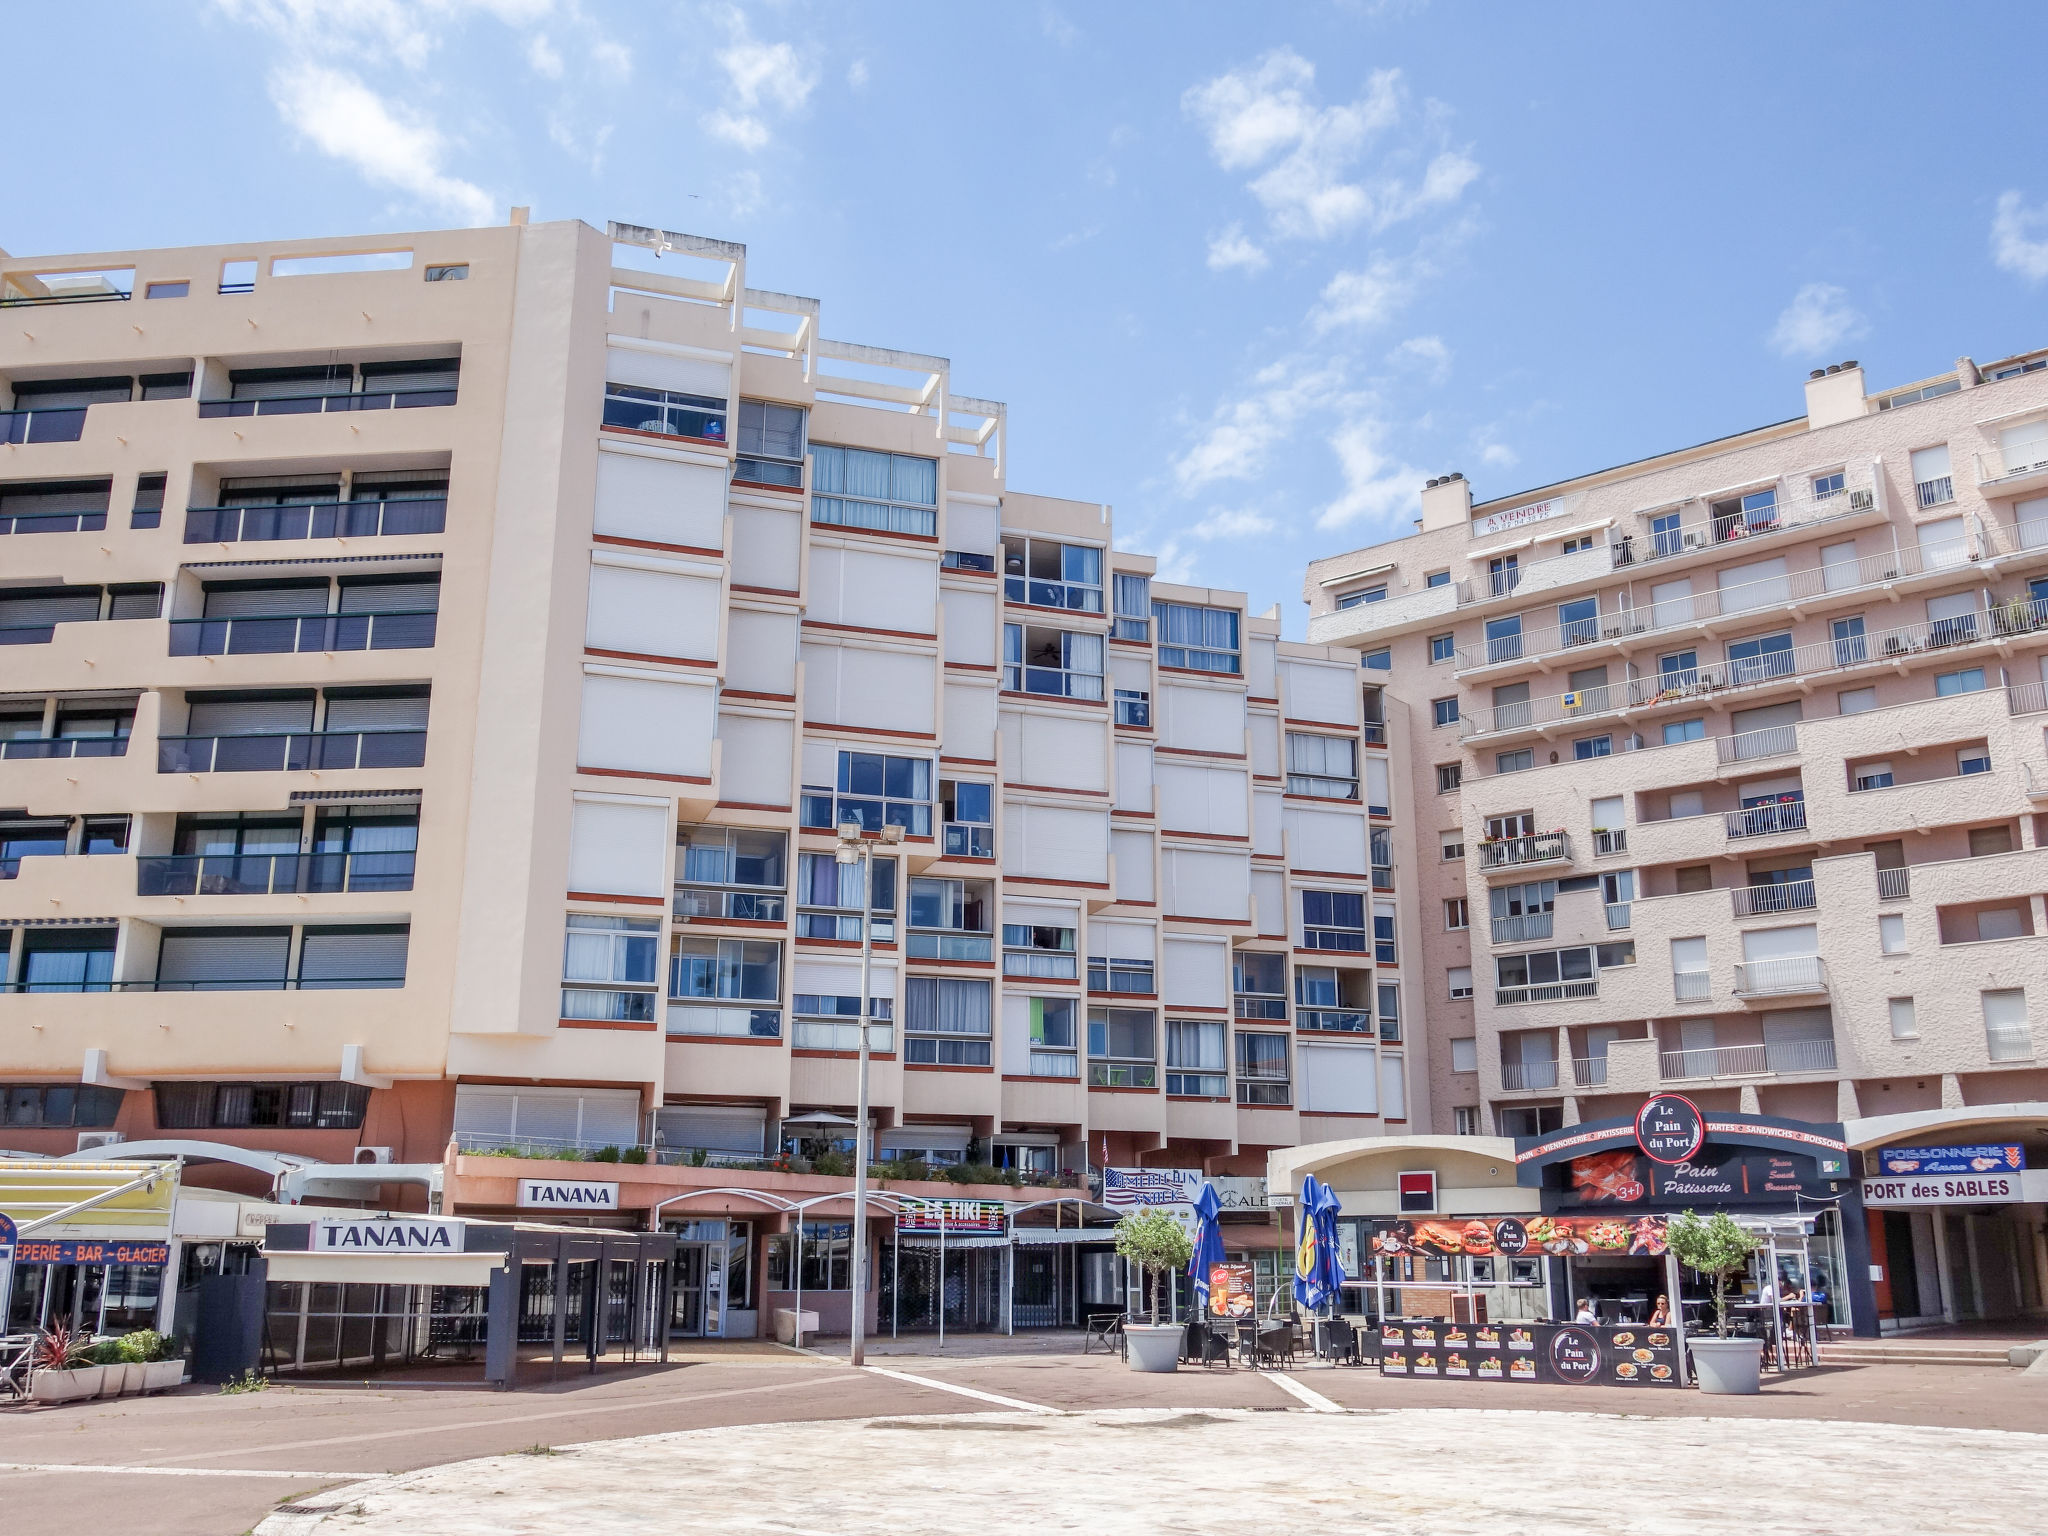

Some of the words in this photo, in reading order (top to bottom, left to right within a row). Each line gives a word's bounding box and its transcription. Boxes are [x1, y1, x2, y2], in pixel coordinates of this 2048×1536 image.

[1500, 503, 1551, 522] VENDRE
[1660, 1105, 1673, 1115] Le
[1655, 1120, 1681, 1132] Pain
[1649, 1138, 1663, 1148] du
[1666, 1137, 1690, 1148] Port
[1707, 1123, 1735, 1132] TARTES
[1746, 1125, 1793, 1138] SANDWICHS
[1803, 1133, 1845, 1150] BOISSONS
[1518, 1152, 1534, 1162] PAIN
[1543, 1134, 1588, 1152] VIENNOISERIE
[1883, 1146, 2004, 1160] POISSONNERIE
[1674, 1161, 1719, 1178] Pain
[528, 1185, 611, 1204] TANANA
[1134, 1189, 1179, 1206] SNACK
[1618, 1183, 1641, 1199] 3+1
[1864, 1183, 1906, 1199] PORT
[1912, 1183, 1940, 1198] des
[1944, 1180, 2010, 1197] SABLES
[949, 1201, 981, 1220] TIKI
[323, 1226, 451, 1247] TANANA
[76, 1246, 103, 1261] BAR
[117, 1246, 167, 1262] GLACIER
[1568, 1337, 1578, 1345] Le
[1565, 1348, 1584, 1358] Pain
[1561, 1361, 1571, 1370] du
[1573, 1361, 1589, 1370] Port
